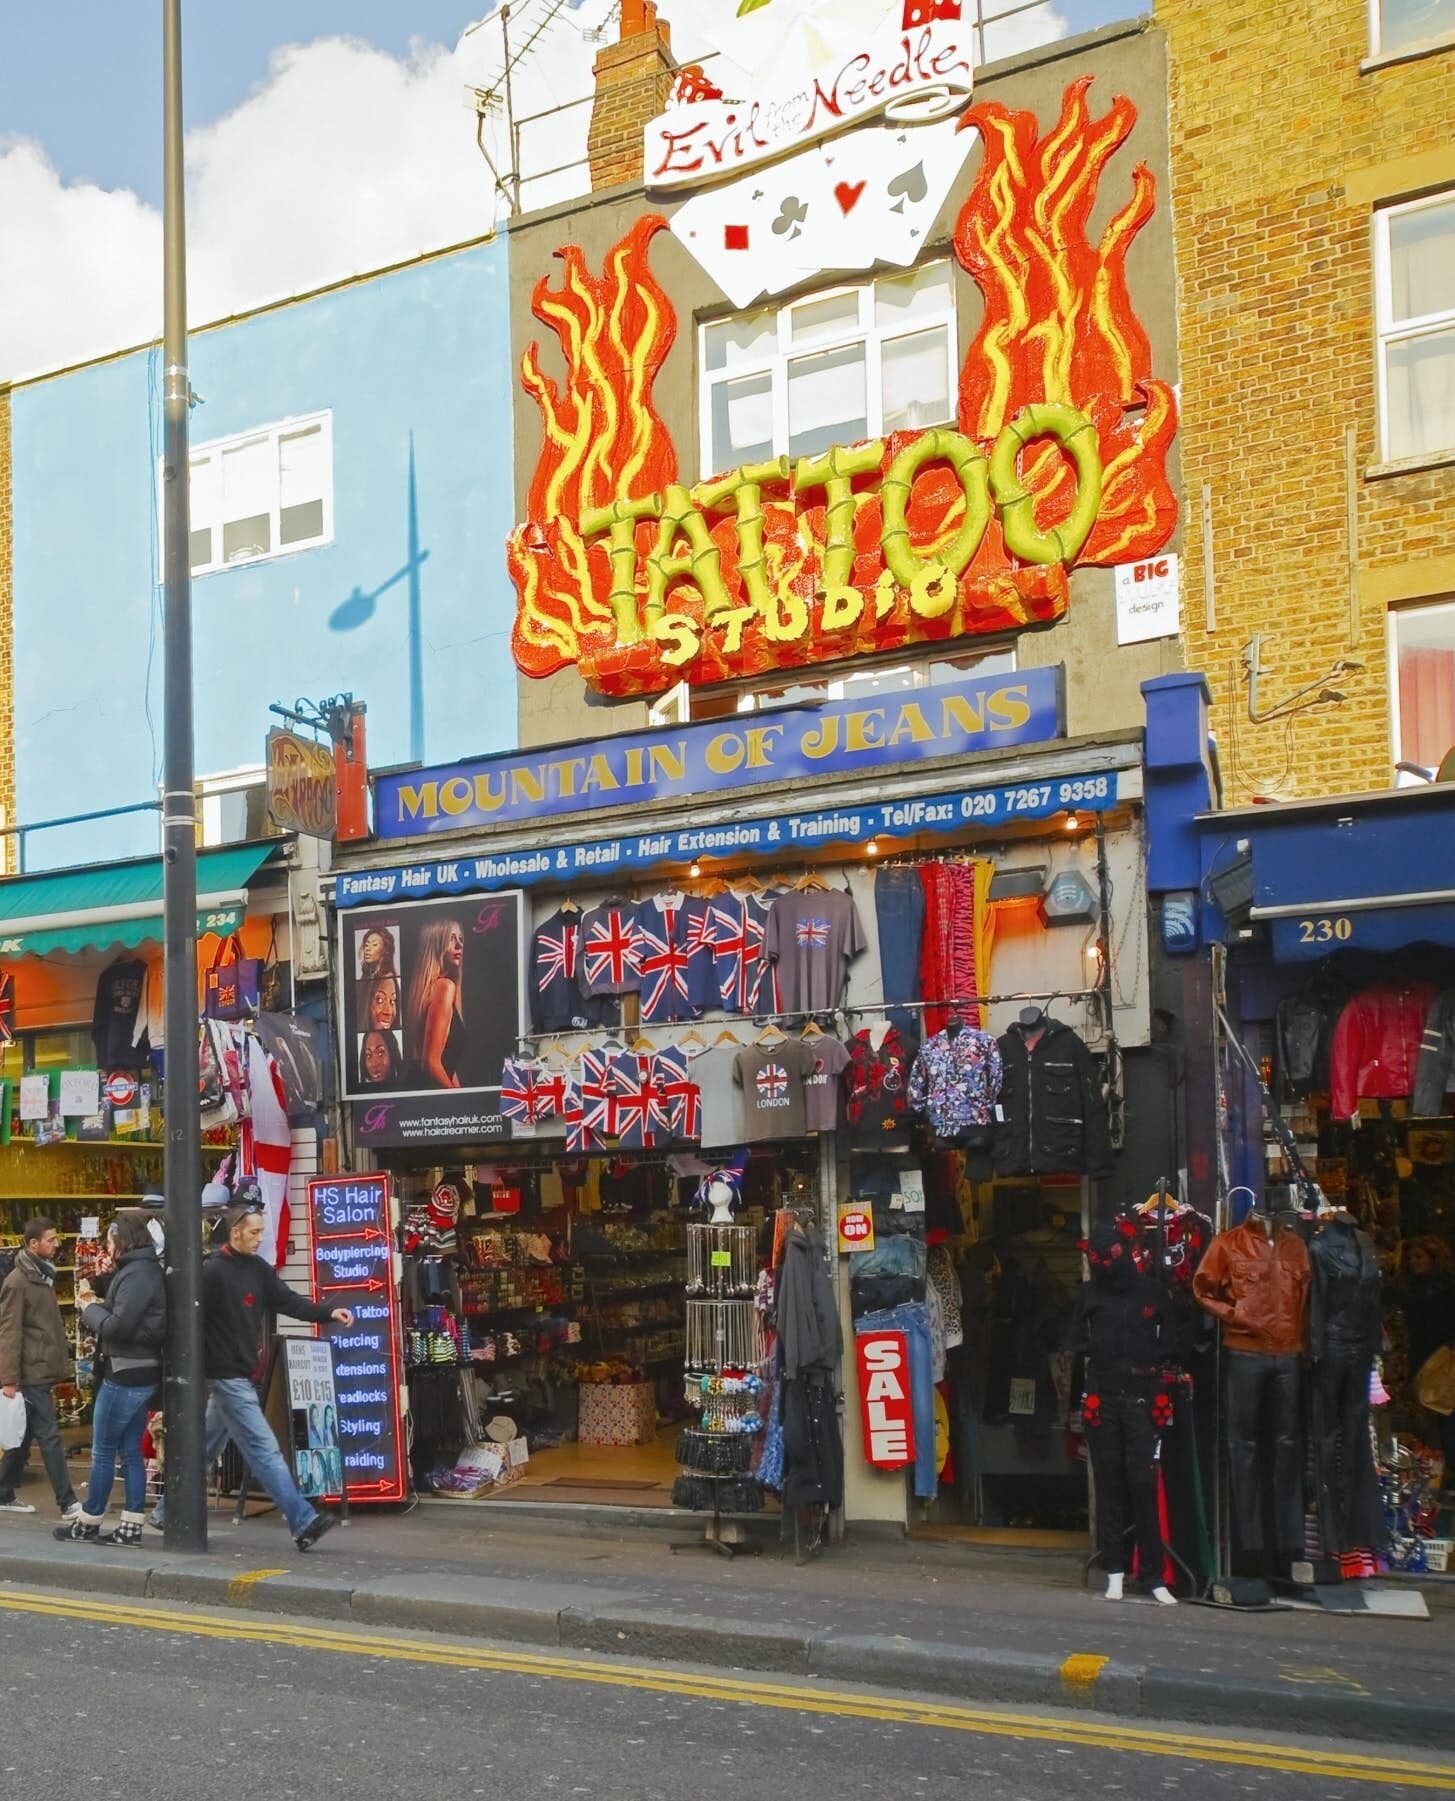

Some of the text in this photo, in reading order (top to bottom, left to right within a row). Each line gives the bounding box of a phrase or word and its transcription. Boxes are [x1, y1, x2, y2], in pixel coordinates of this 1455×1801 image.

[652, 101, 769, 177] Evil
[799, 26, 971, 134] Needle
[580, 403, 1100, 648] TATTOO
[1134, 560, 1169, 583] BIG
[1129, 601, 1164, 615] design
[397, 741, 687, 823] MOUNTAIN
[705, 725, 784, 776] OF
[800, 685, 1032, 760] JEANS
[343, 777, 1108, 896] Fantasy Hair UK Wholesale & Retail Hair Extension & Training Tel/Fax: 020 7267 9358
[206, 912, 236, 928] 234
[1298, 918, 1353, 942] 230
[756, 1097, 791, 1109] LONDON
[399, 1113, 502, 1129] www.fantasyhairuk.com
[314, 1186, 383, 1205] HS Hair
[323, 1206, 375, 1224] Salon
[845, 1214, 864, 1224] NOW
[844, 1223, 868, 1236] ON
[316, 1244, 390, 1264] Bodypiercing
[333, 1263, 369, 1279] Studio
[355, 1305, 390, 1319] Tattoo
[335, 1363, 387, 1377] tensions
[292, 1379, 312, 1401] £10
[313, 1380, 332, 1402] £15
[864, 1339, 909, 1462] SALE
[340, 1420, 381, 1437] Styling
[345, 1455, 385, 1470] raiding
